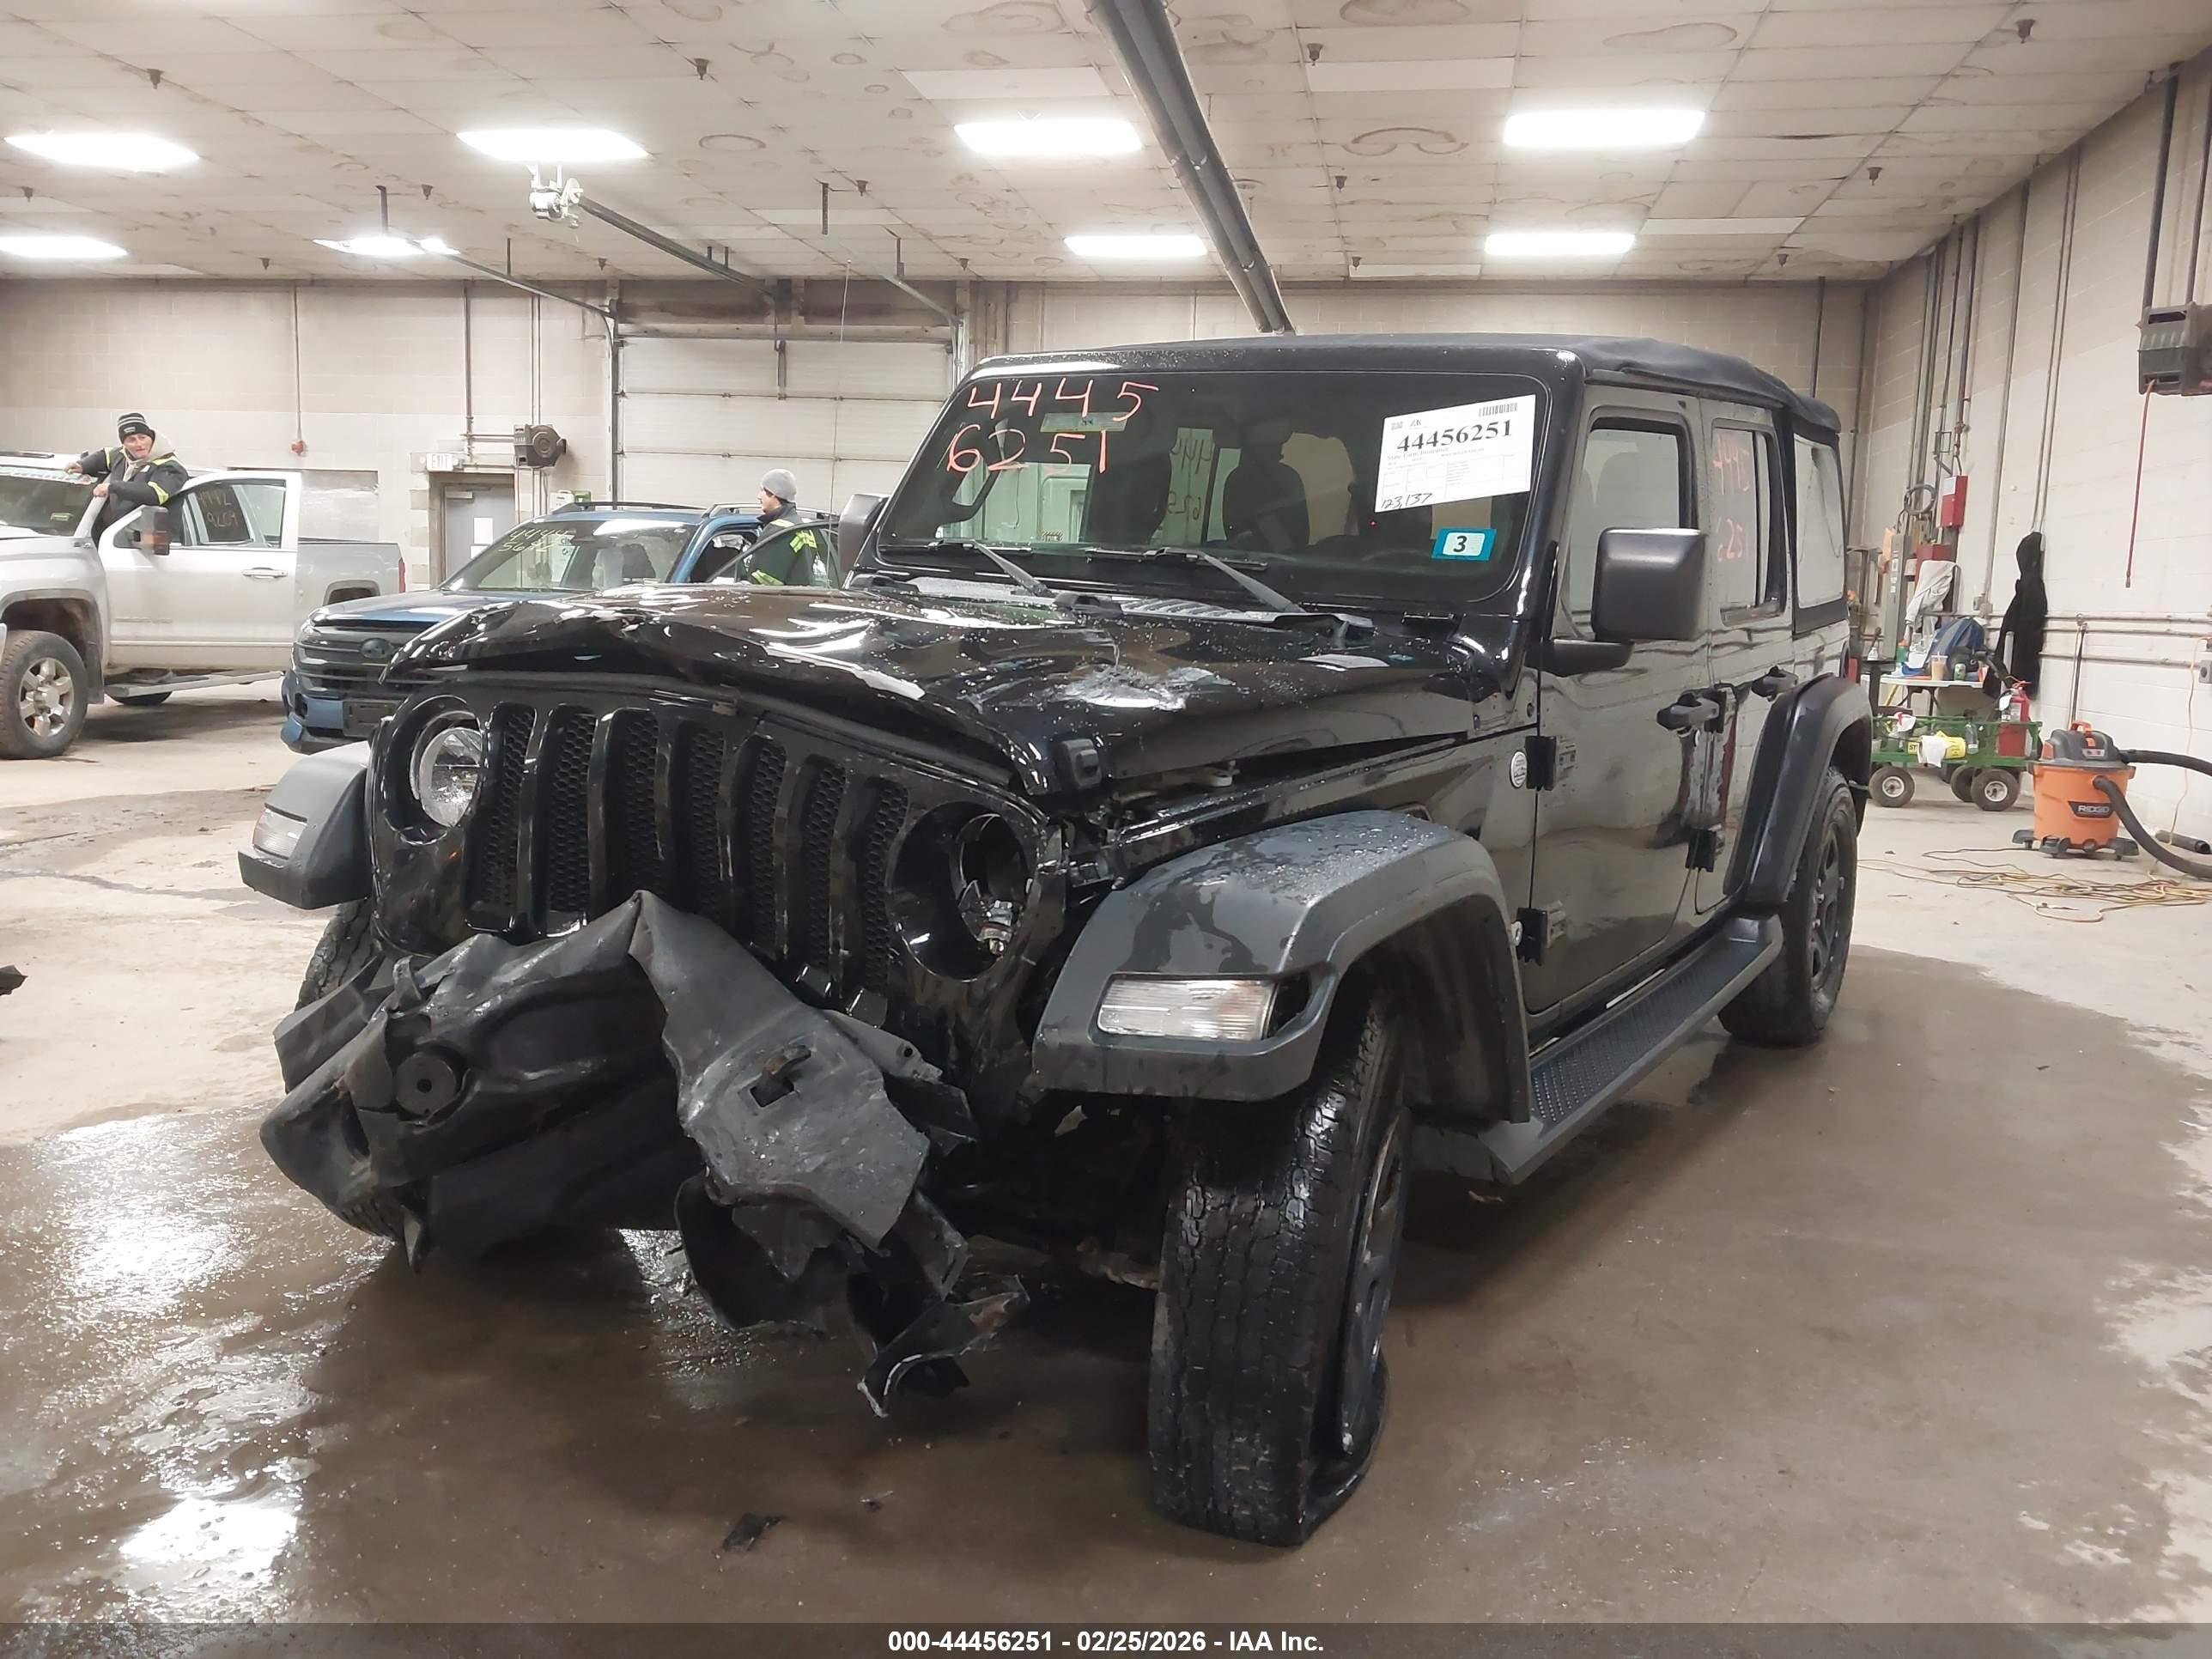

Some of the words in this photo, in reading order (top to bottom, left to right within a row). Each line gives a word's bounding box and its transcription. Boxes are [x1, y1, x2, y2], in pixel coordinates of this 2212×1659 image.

[945, 423, 1108, 474] 6251
[1396, 419, 1512, 453] 44456251
[1381, 493, 1433, 509] 123,137
[1452, 535, 1468, 553] 3
